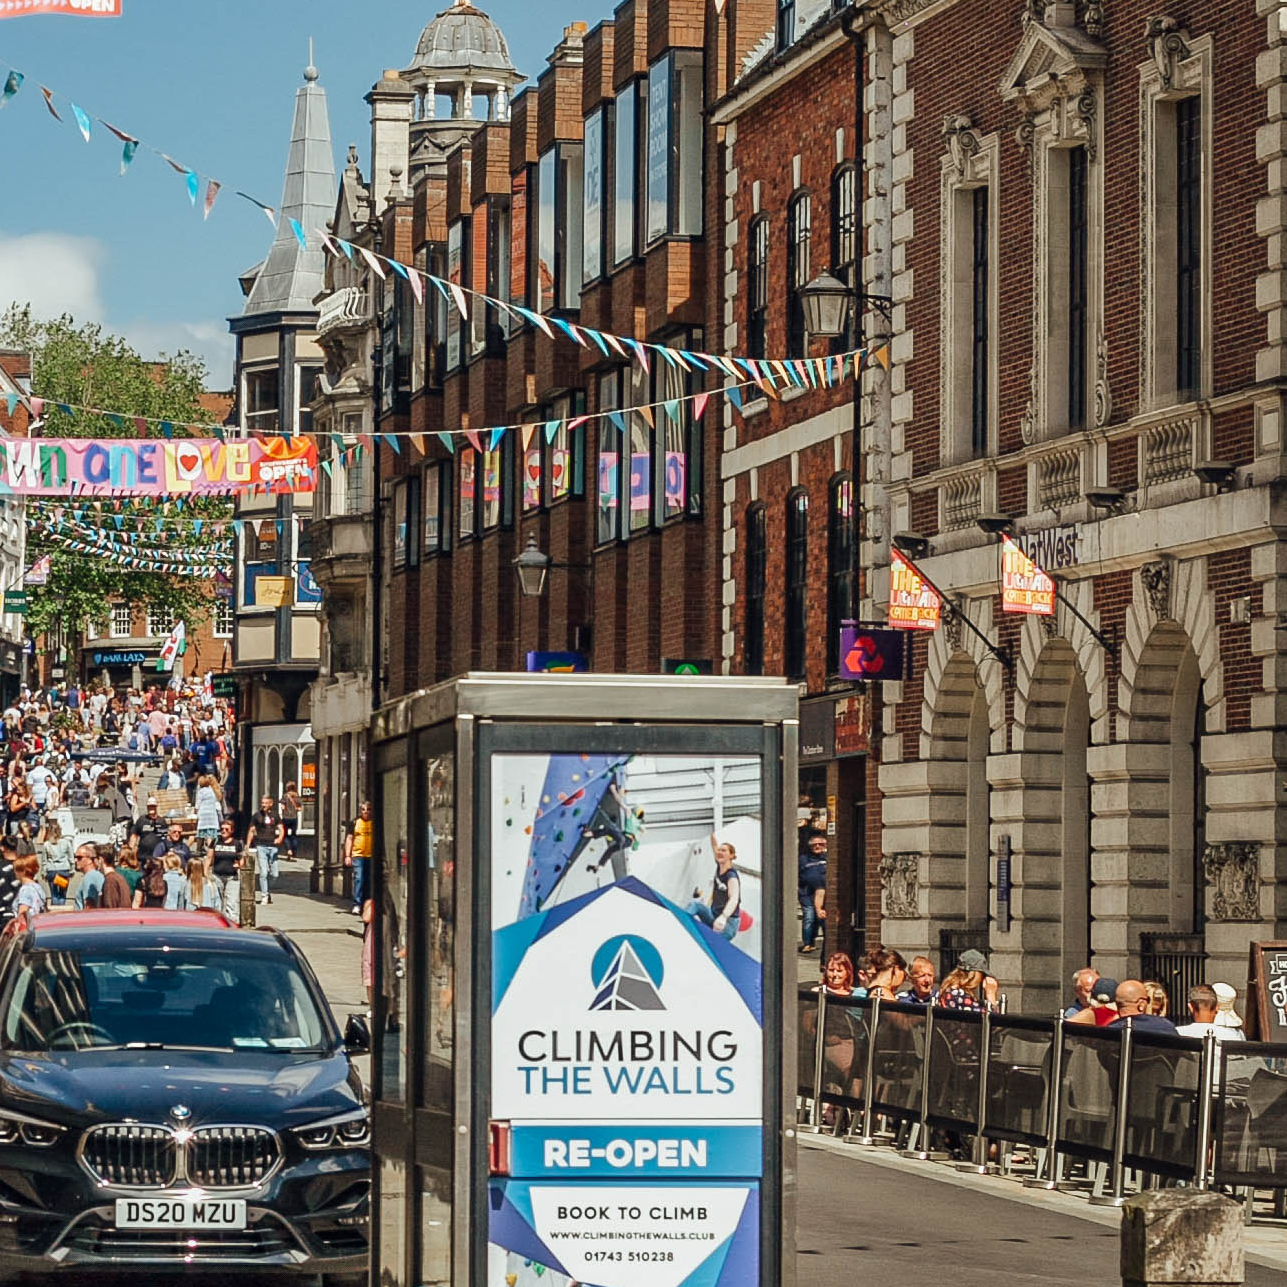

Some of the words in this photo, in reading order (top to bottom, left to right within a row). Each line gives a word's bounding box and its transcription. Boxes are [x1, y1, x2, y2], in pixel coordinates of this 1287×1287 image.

[259, 464, 309, 481] OPEN
[518, 1030, 738, 1062] CLIMBING
[517, 1066, 592, 1095] THE
[603, 1066, 735, 1095] WALLS
[544, 1139, 708, 1168] RE-OPEN
[127, 1203, 185, 1222] DS20
[193, 1203, 235, 1223] MZU
[558, 1207, 611, 1220] BOOK
[618, 1207, 641, 1220] TO
[649, 1207, 708, 1220] CLIMB
[550, 1232, 715, 1241] WWW.CLIMBINGTHEWALLS.CLUB
[584, 1252, 623, 1262] 01743
[628, 1252, 674, 1262] 510238
